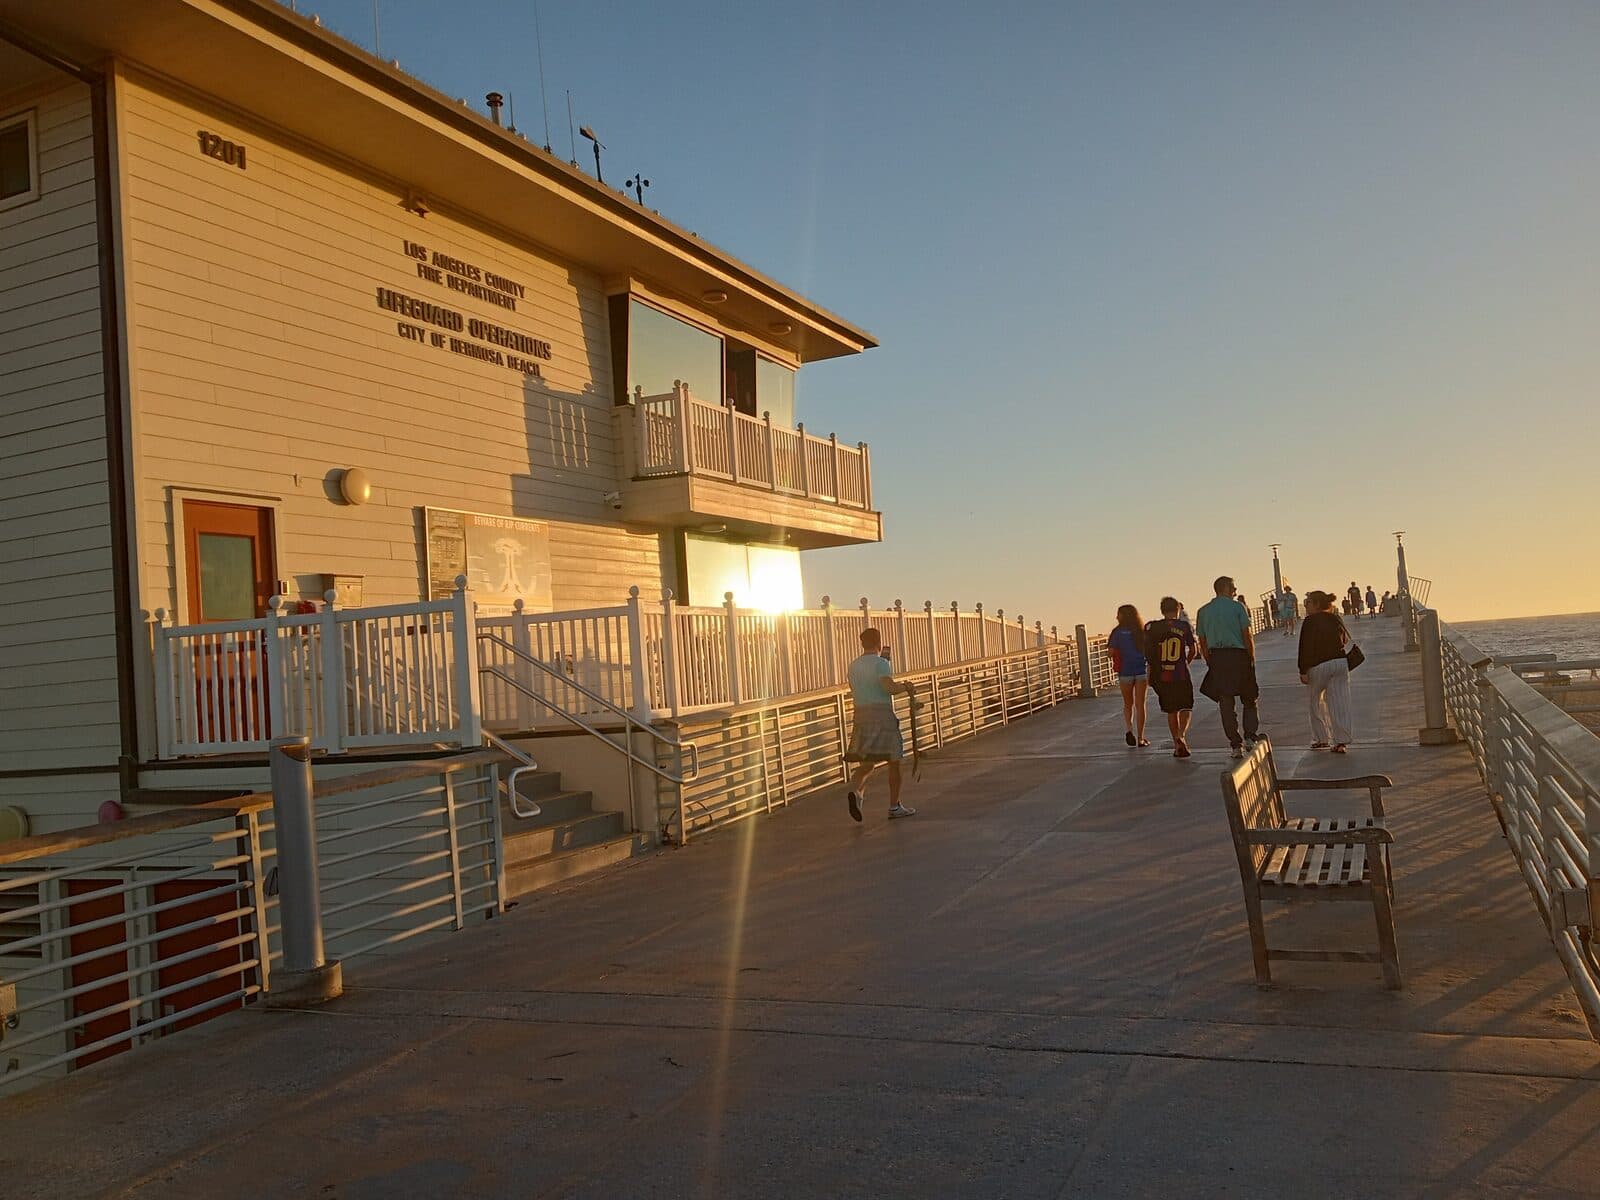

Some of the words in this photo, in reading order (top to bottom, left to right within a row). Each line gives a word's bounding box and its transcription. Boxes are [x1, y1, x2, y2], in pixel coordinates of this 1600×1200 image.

[197, 130, 246, 170] 1201
[403, 240, 427, 261] LOS
[432, 252, 481, 282] ANGELES
[485, 272, 525, 298] COUNTY
[417, 263, 443, 285] FIRE
[446, 274, 516, 311] DEPARTMENT
[377, 287, 463, 332] LIFEGUARD
[468, 318, 551, 360] OPERATIONS
[398, 323, 425, 343] CITY
[431, 332, 446, 348] OF
[450, 338, 504, 366] HERMOSA
[507, 355, 541, 376] BEACH
[1159, 638, 1181, 661] 10
